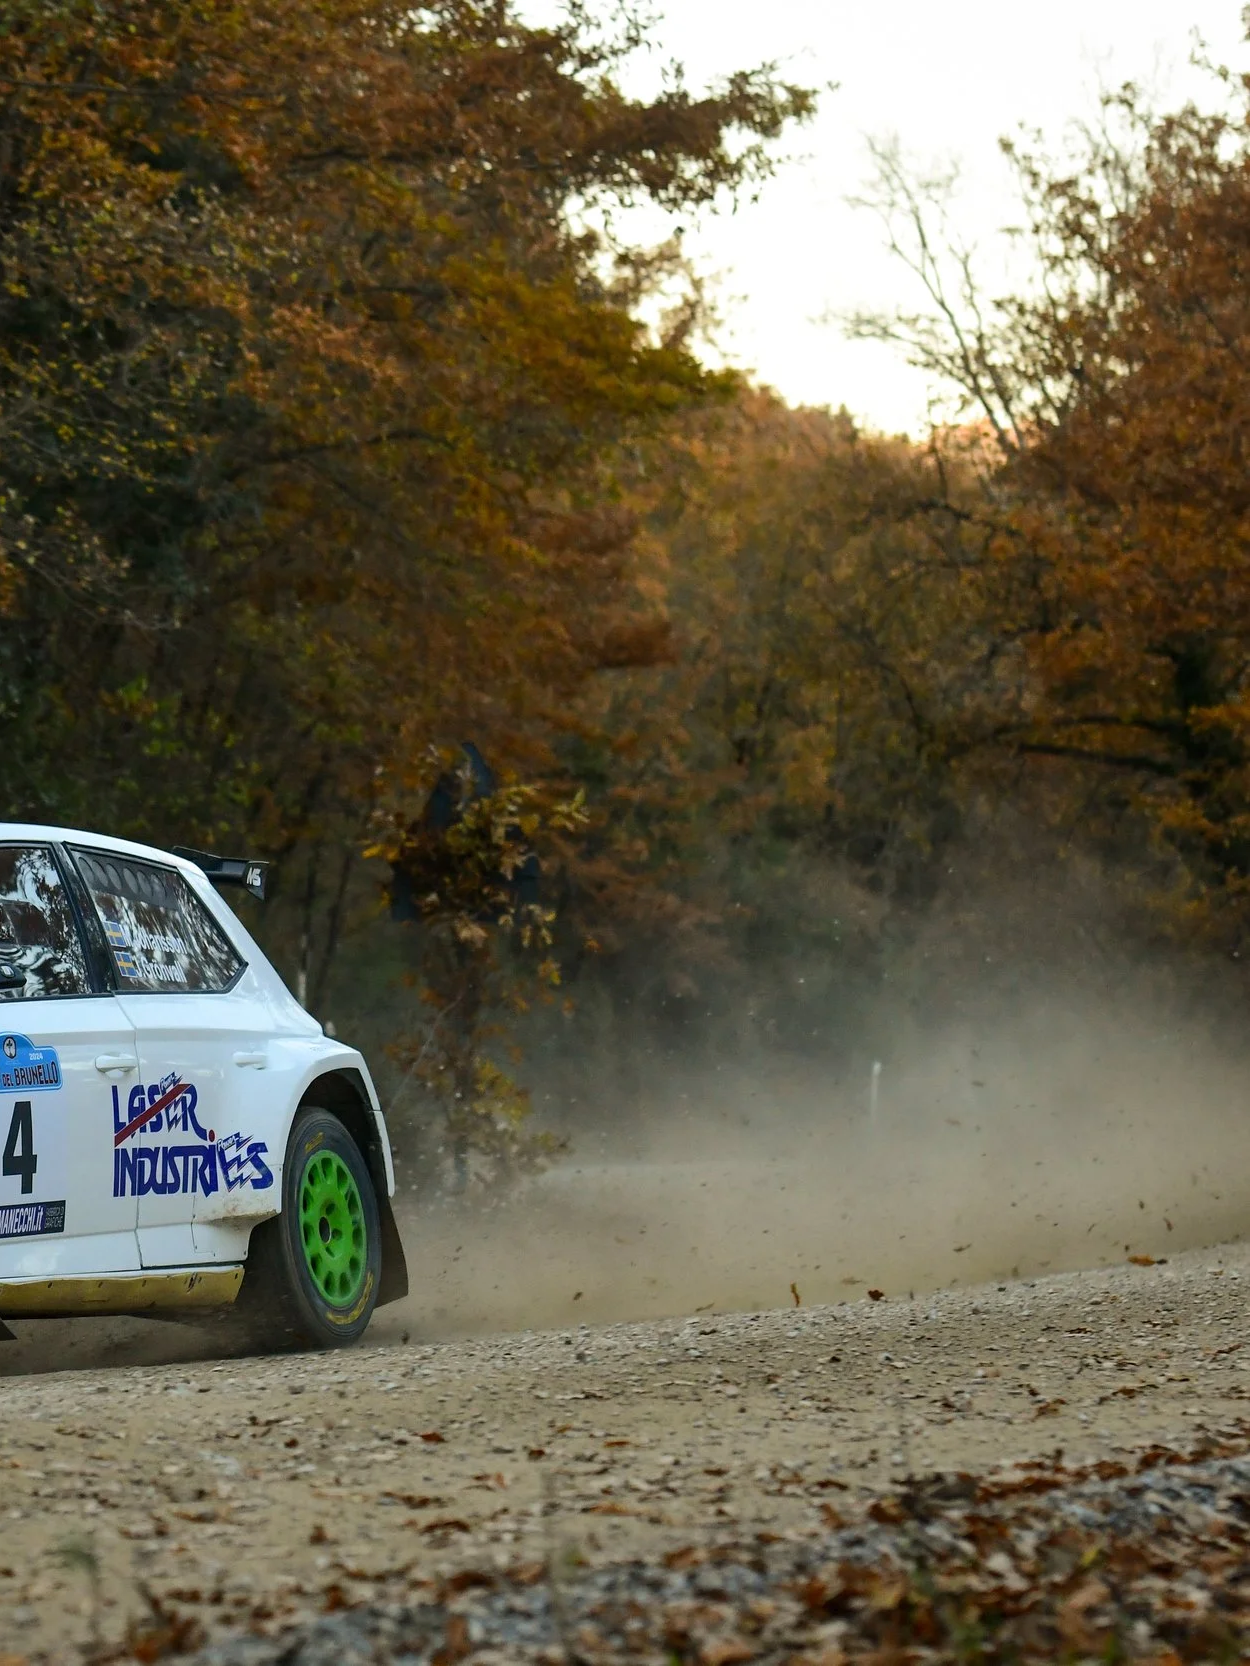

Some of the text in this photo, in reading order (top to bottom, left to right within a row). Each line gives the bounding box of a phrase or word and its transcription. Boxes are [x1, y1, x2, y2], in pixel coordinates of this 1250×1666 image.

[246, 866, 261, 887] MS
[132, 955, 187, 983] J.Grönvall
[29, 1052, 43, 1060] 2024
[14, 1061, 59, 1086] BRUNELLO
[112, 1084, 207, 1142] LASER
[2, 1101, 37, 1194] 4
[113, 1138, 274, 1198] INDUSTRIES
